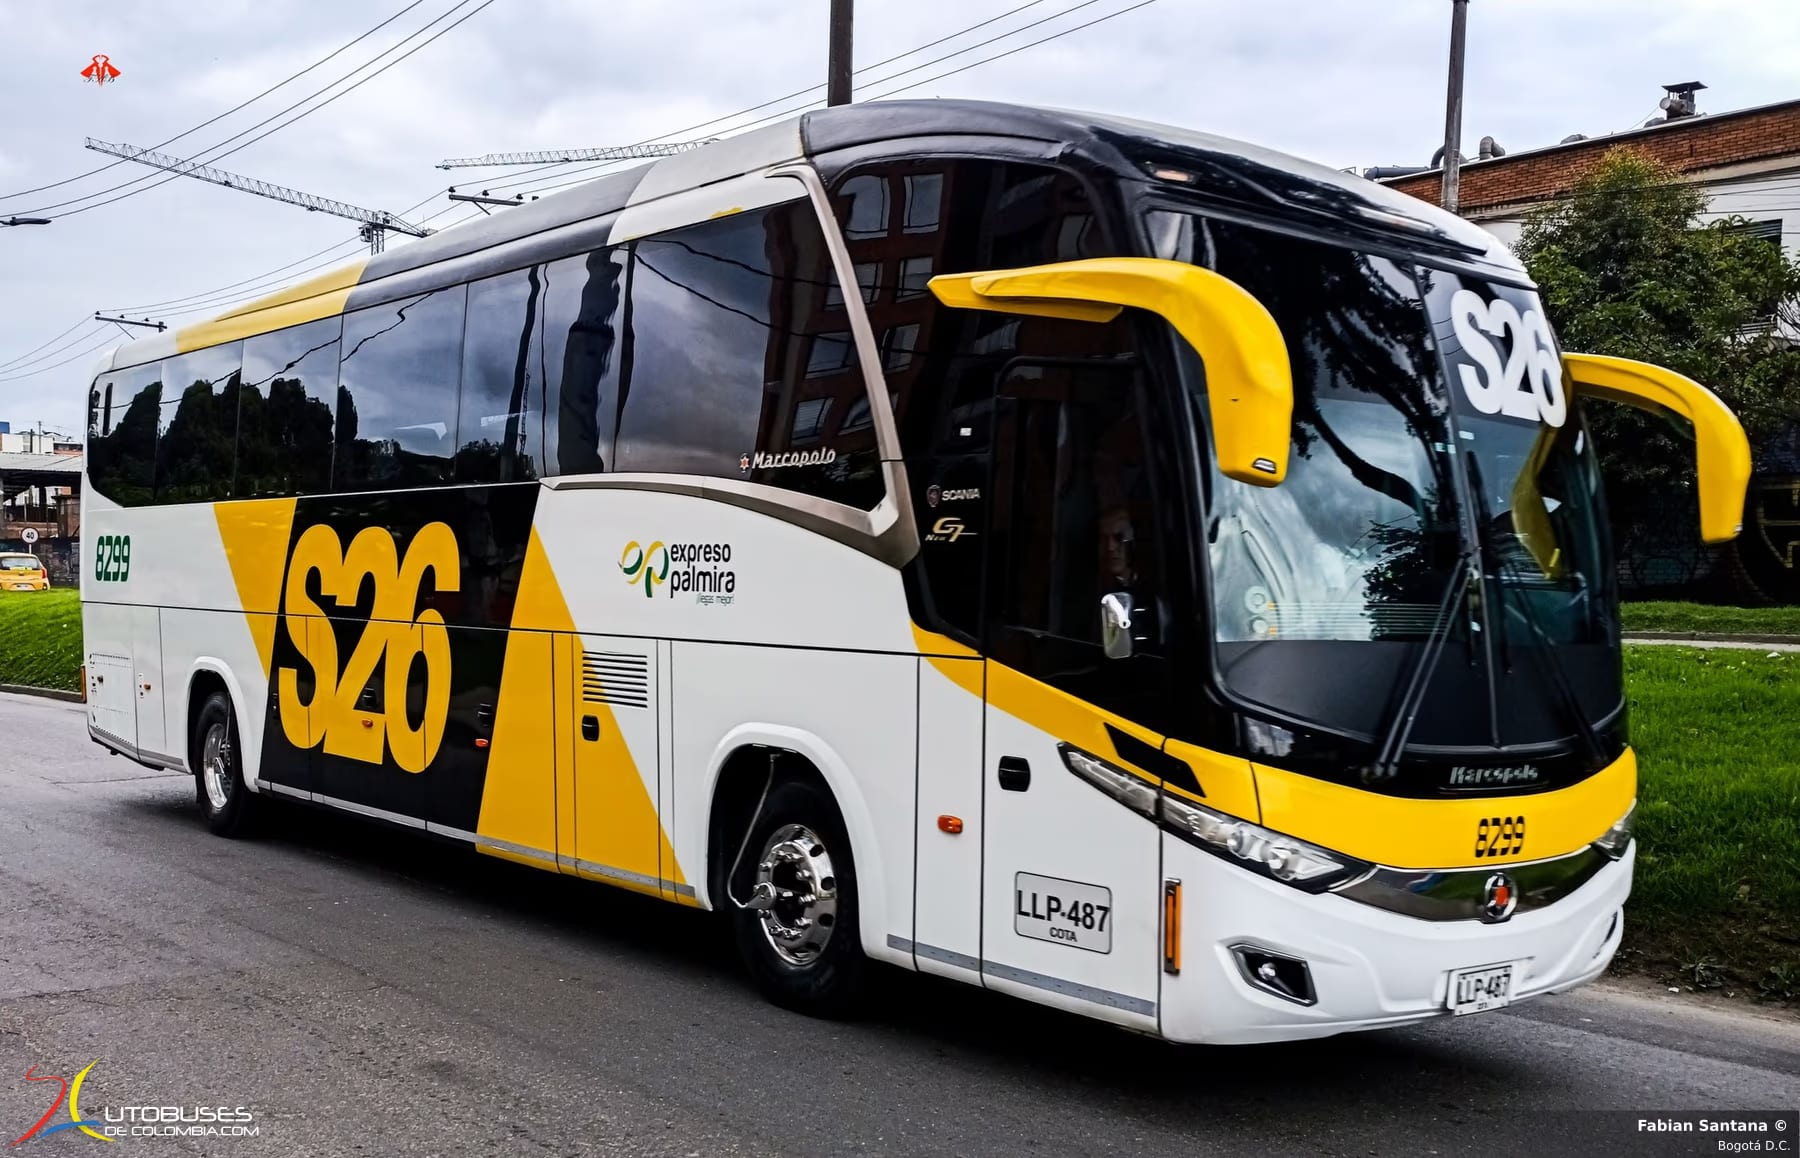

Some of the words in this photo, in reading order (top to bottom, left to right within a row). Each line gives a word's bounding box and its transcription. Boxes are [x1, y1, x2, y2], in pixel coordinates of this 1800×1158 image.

[1451, 289, 1567, 428] S26
[752, 447, 836, 469] Marcopolo
[941, 488, 981, 501] SCANIA
[26, 531, 34, 540] 40
[95, 535, 131, 582] 8299
[670, 543, 731, 568] expreso
[670, 565, 736, 599] palmira
[279, 521, 461, 774] S26
[1475, 815, 1525, 858] 8299
[1050, 926, 1077, 943] COTA
